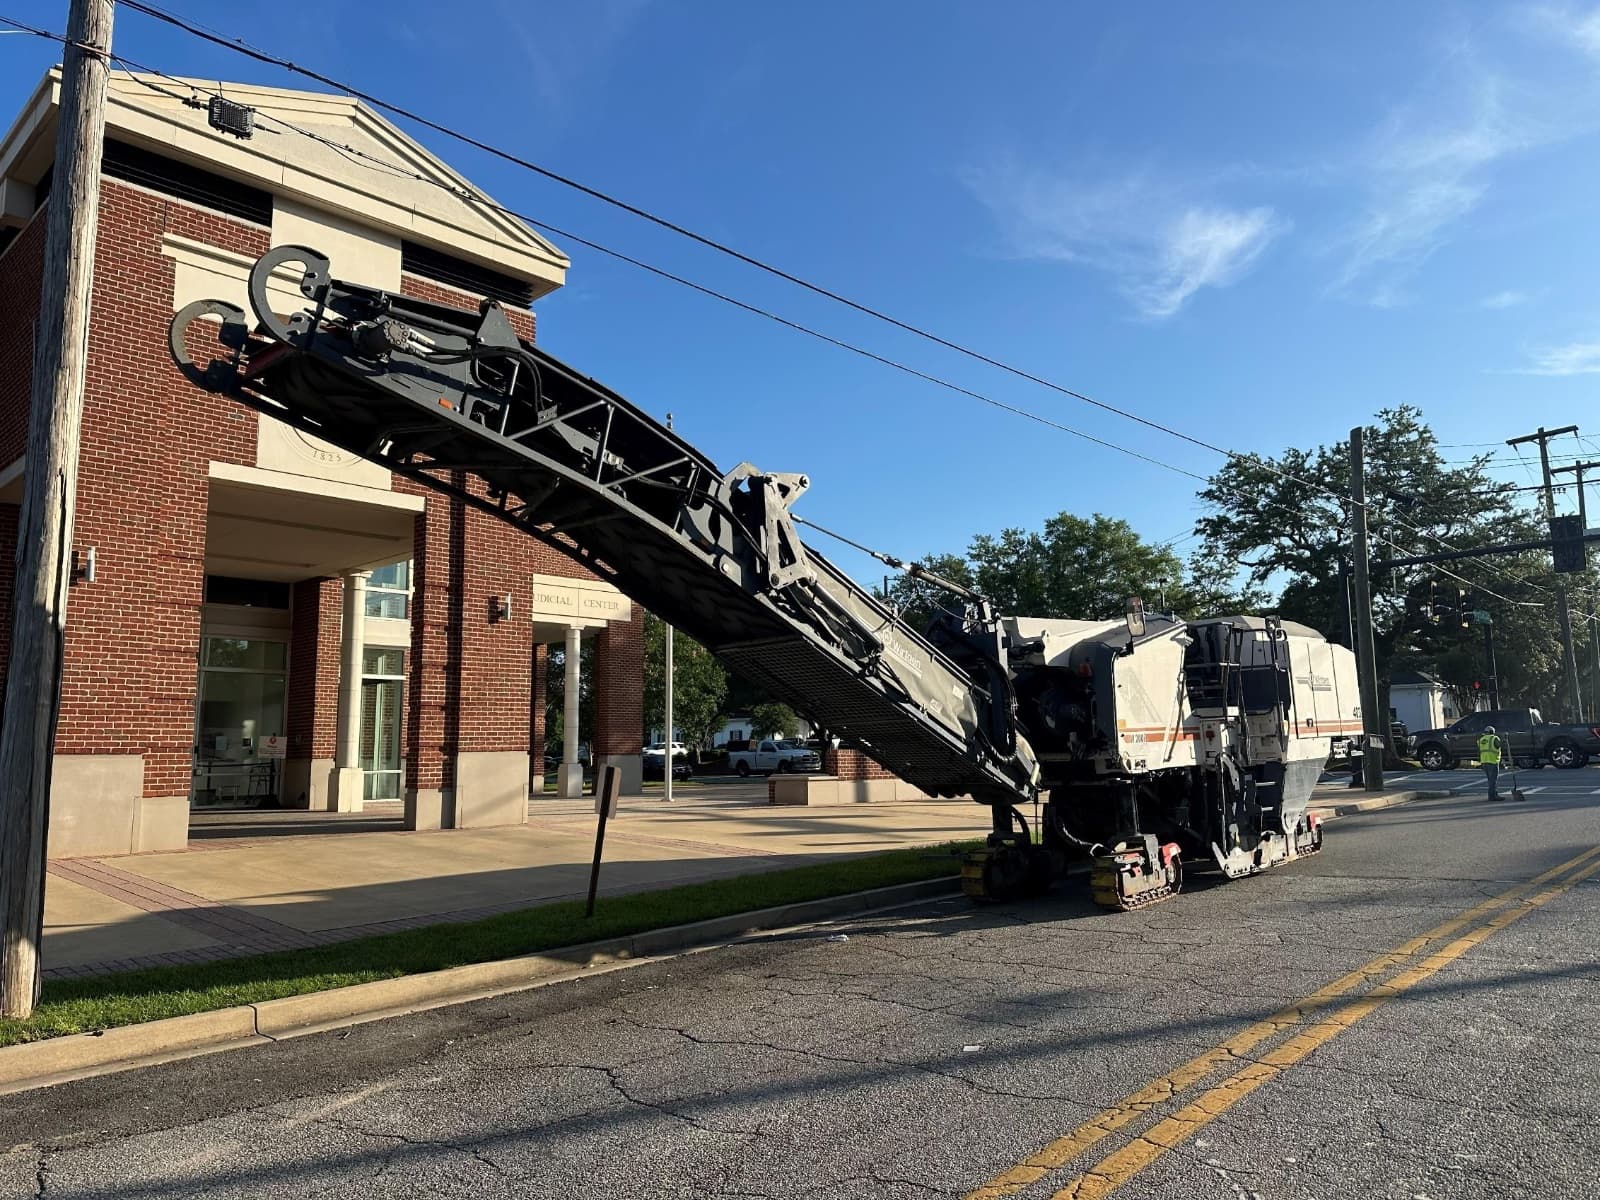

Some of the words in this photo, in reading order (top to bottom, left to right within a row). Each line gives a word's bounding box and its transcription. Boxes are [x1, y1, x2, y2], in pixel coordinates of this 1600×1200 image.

[312, 450, 342, 462] 1825
[533, 594, 573, 606] UDICIAL
[583, 599, 619, 610] CENTER
